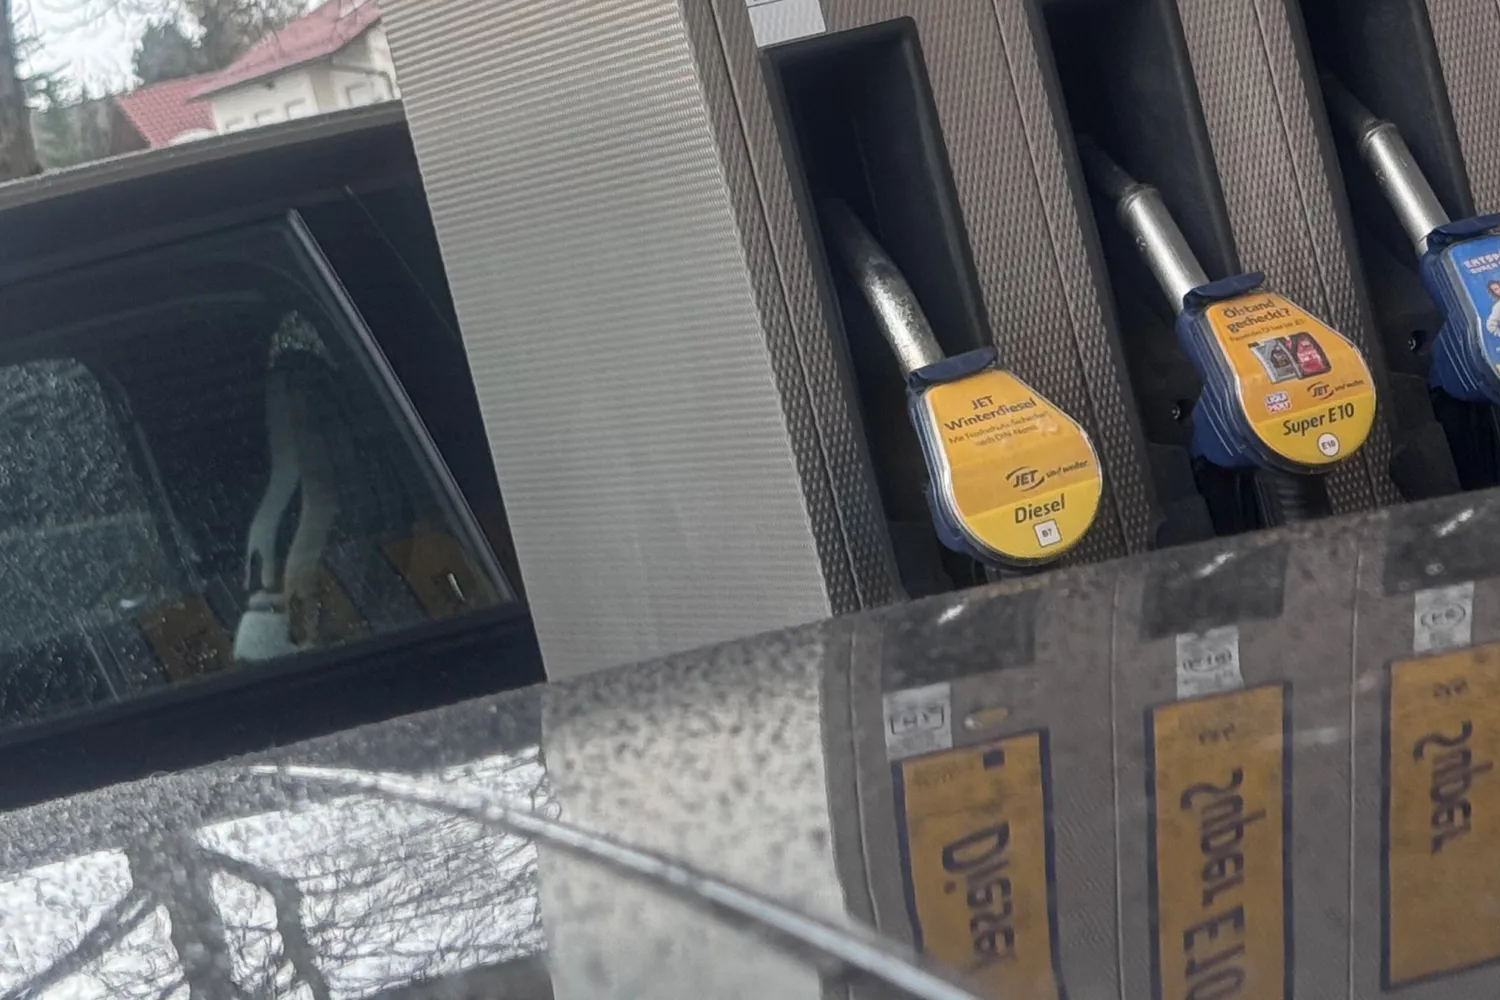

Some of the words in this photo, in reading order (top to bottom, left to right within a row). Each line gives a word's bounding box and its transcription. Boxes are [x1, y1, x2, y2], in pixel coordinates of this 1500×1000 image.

[1312, 384, 1330, 397] JET
[972, 395, 994, 410] JET
[944, 397, 1037, 431] Winterdiesel
[1283, 414, 1325, 436] Super
[1328, 403, 1355, 423] E10
[1321, 440, 1336, 450] E10
[1013, 469, 1038, 488] JET
[1014, 493, 1065, 524] Diesel
